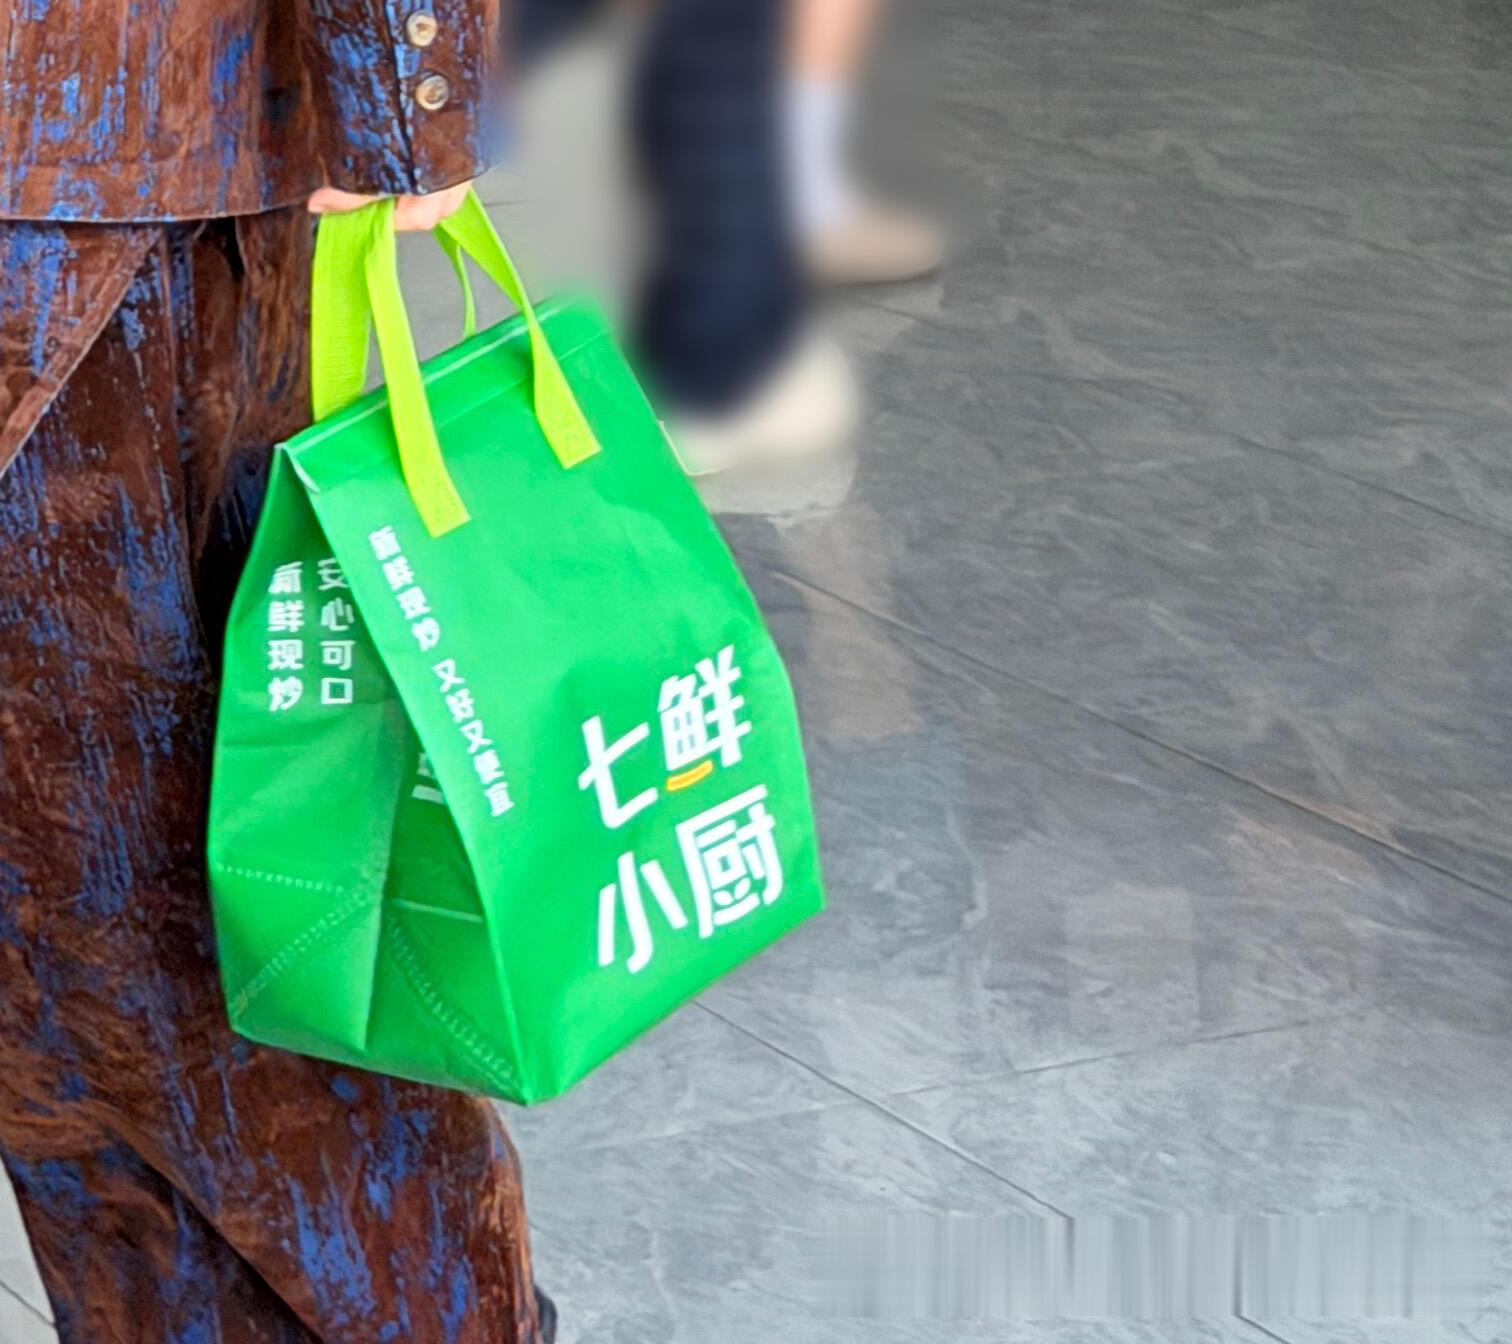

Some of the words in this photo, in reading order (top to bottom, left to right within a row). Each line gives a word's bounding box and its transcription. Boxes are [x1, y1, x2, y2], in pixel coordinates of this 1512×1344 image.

[317, 557, 356, 705] 安心可口
[577, 643, 753, 830] 七鲜
[597, 782, 784, 975] 小厨
